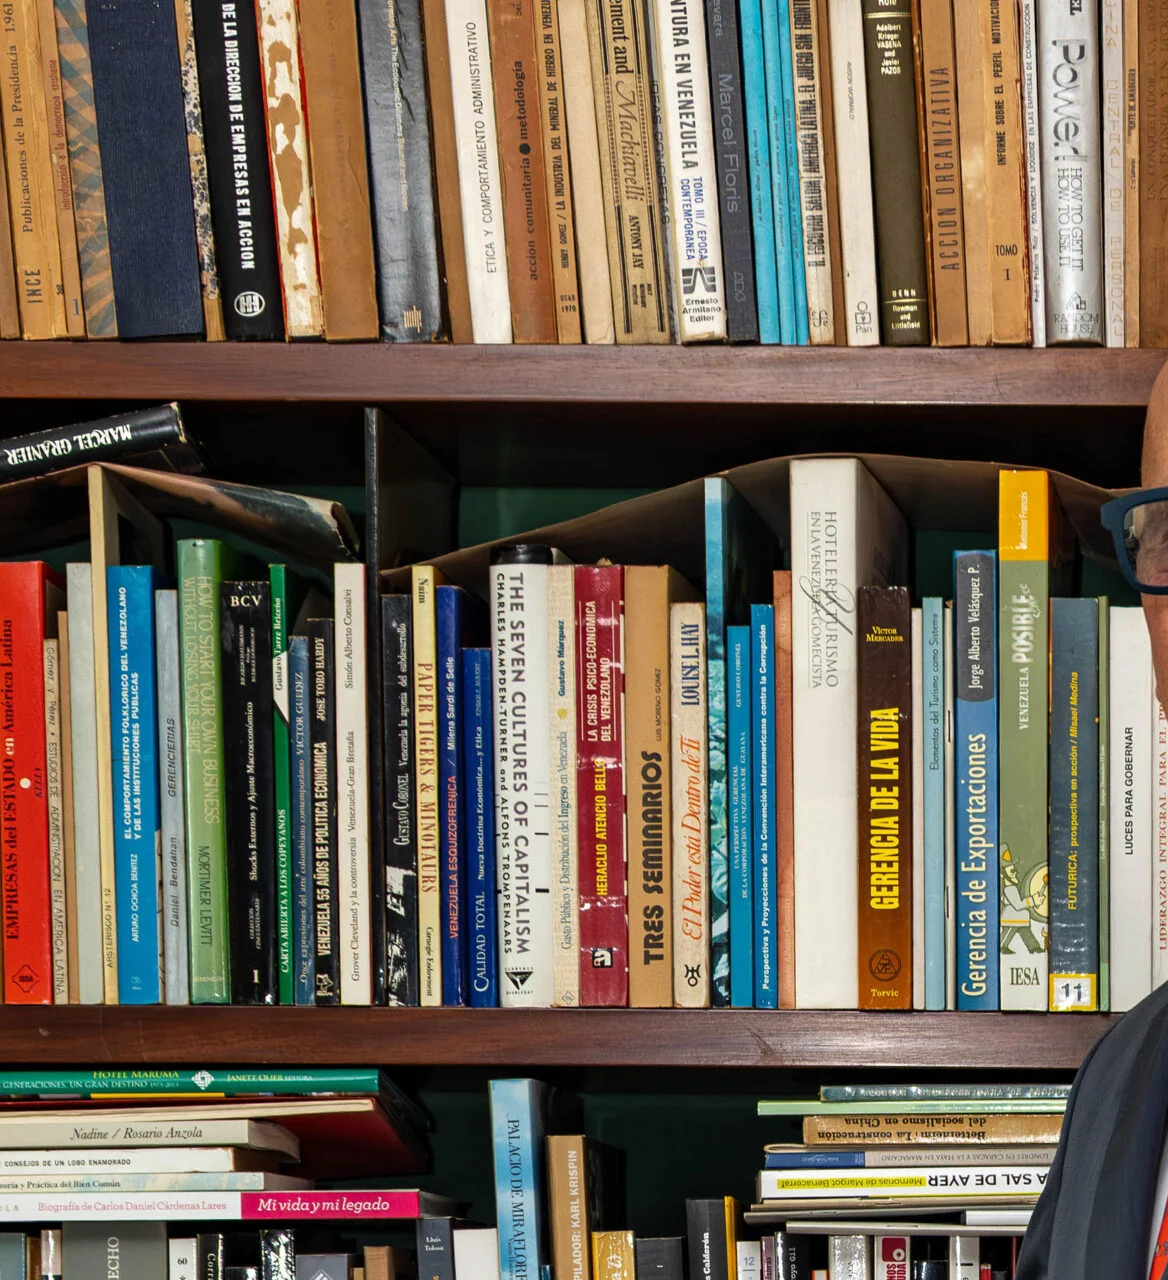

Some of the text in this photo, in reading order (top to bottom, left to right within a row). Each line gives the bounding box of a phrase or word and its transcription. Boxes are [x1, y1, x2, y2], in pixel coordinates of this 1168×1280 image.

[3, 3, 34, 233] Publicaciones de la Presidencia 1.961
[222, 3, 255, 269] DE LA DIRECCION DE EMPRESAS EN ACCION
[465, 22, 497, 274] ETICA Y COMPORTAMIENTO ADMINISTRATIVO
[674, 53, 699, 169] EN VENEZUELA
[719, 74, 741, 213] Marcel Floris
[929, 67, 960, 271] ACCION ORGANIZATIVA
[680, 179, 695, 261] CONTEMPORANEA
[26, 269, 42, 304] INCE
[6, 424, 132, 466] MARCEL GRANIER
[230, 595, 261, 607] BCV
[342, 589, 353, 688] Simón Alberto Consalvi
[968, 565, 984, 688] Jorge Alberto Velásquez P.
[0, 620, 19, 940] EMPRESAS del ESTADO en América Latina
[167, 718, 176, 797] GERENCIERIAS
[418, 663, 436, 893] PAPER TIGERS & MINOTAURS
[497, 573, 512, 954] CHARLES HAMPDEN-TURNER and ALFONS TROMPENAARS
[509, 573, 530, 954] THE SEVEN CULTURES OF CAPITALISM
[870, 707, 899, 909] GERENCIA DE LA VIDA
[1125, 727, 1133, 855] LUCES PARA GOBERNAR
[314, 742, 331, 955] VENEZUELA 55 AÑOS DE POLITICA ECONOMICA
[448, 776, 458, 938] VENEZUELA ESQUIZOFRENICA
[594, 760, 608, 895] HERACLIO ATENCIO BELLO
[641, 750, 664, 965] TRES SEMINARIOS
[961, 733, 994, 996] Gerencia de Exportaciones
[474, 892, 489, 992] CALIDAD TOTAL
[1009, 967, 1040, 987] IESA
[70, 1128, 108, 1140] Nadine
[124, 1127, 162, 1139] Rosario
[166, 1127, 202, 1139] Anzola
[567, 1150, 579, 1195] KRISPIN
[929, 1174, 1032, 1186] SAL DE AYER
[257, 1197, 389, 1214] Mi vida y mi legado
[570, 1198, 581, 1228] KARL
